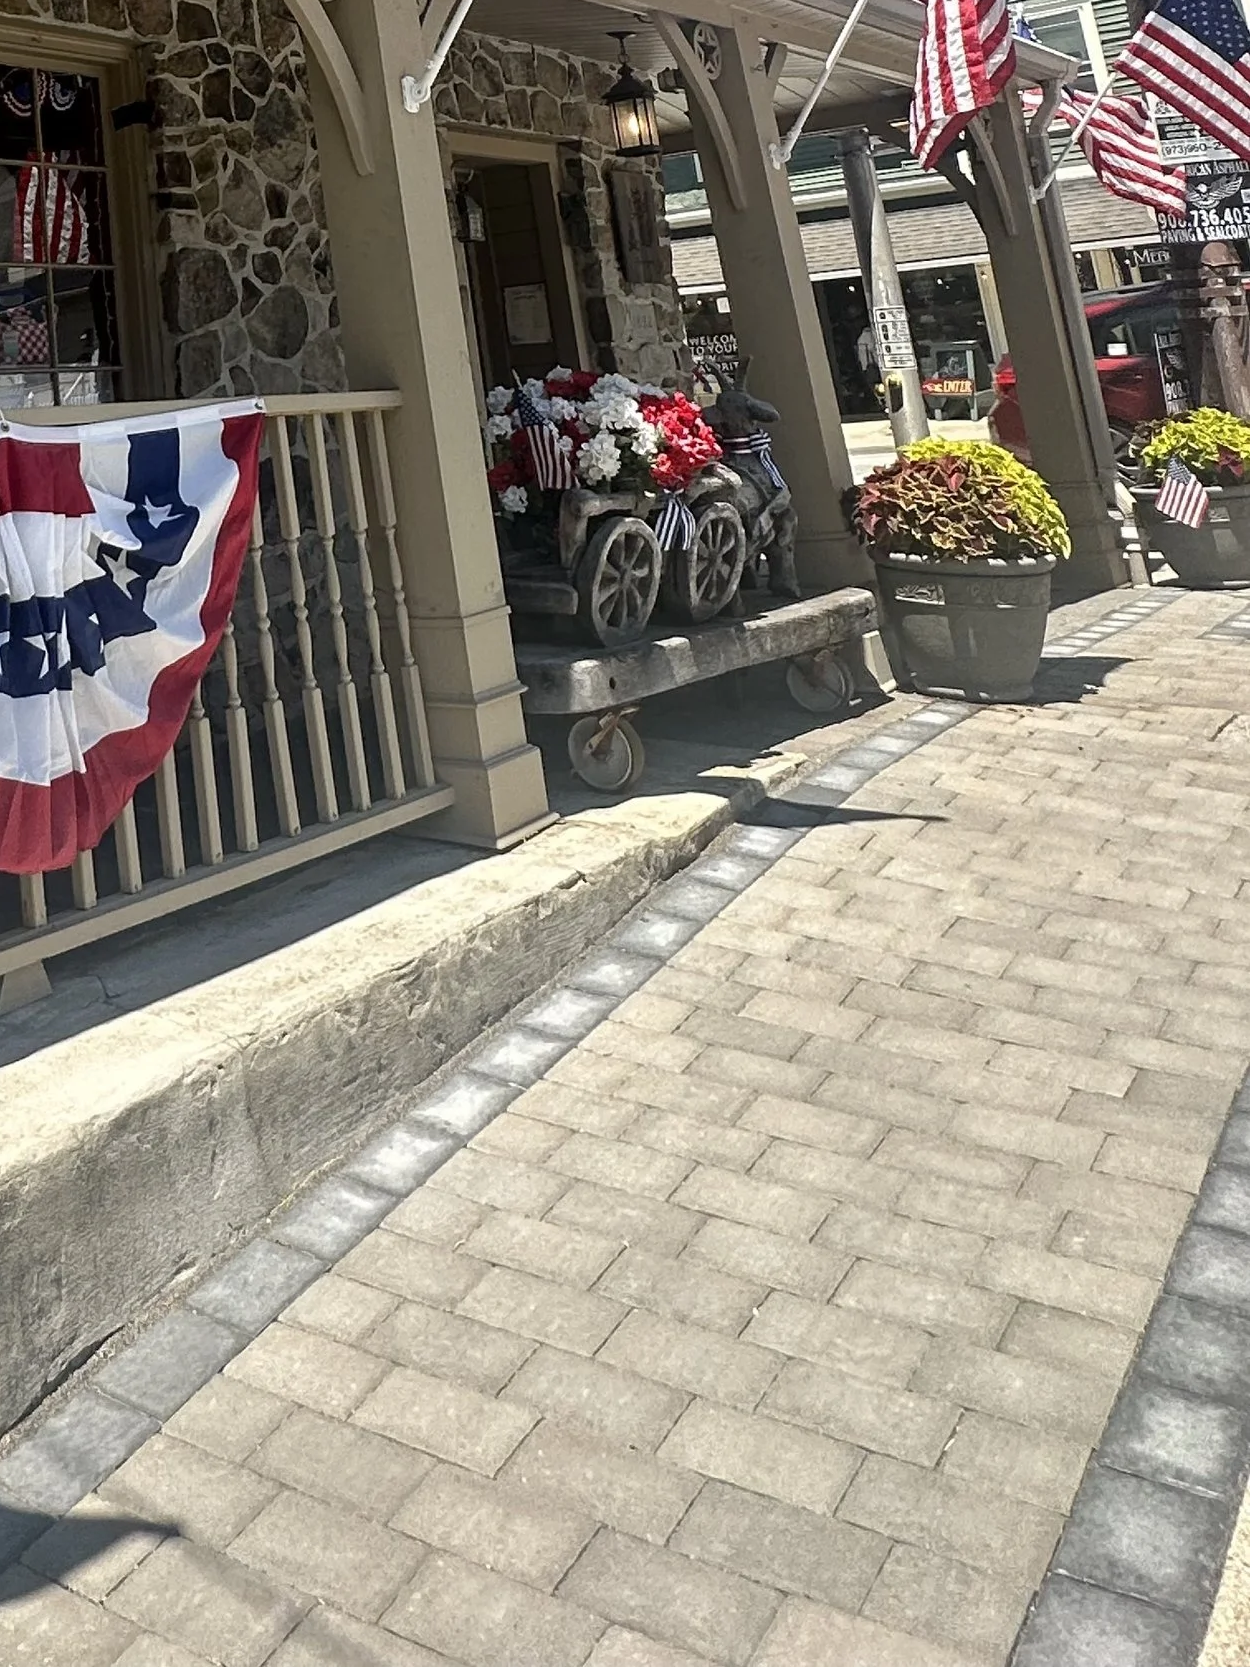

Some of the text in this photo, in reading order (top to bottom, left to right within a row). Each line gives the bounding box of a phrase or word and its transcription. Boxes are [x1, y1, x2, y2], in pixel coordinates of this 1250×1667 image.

[1158, 206, 1250, 230] 90.736.405
[689, 334, 737, 346] WELCOM
[689, 345, 705, 356] TO
[943, 379, 973, 393] ENTER
